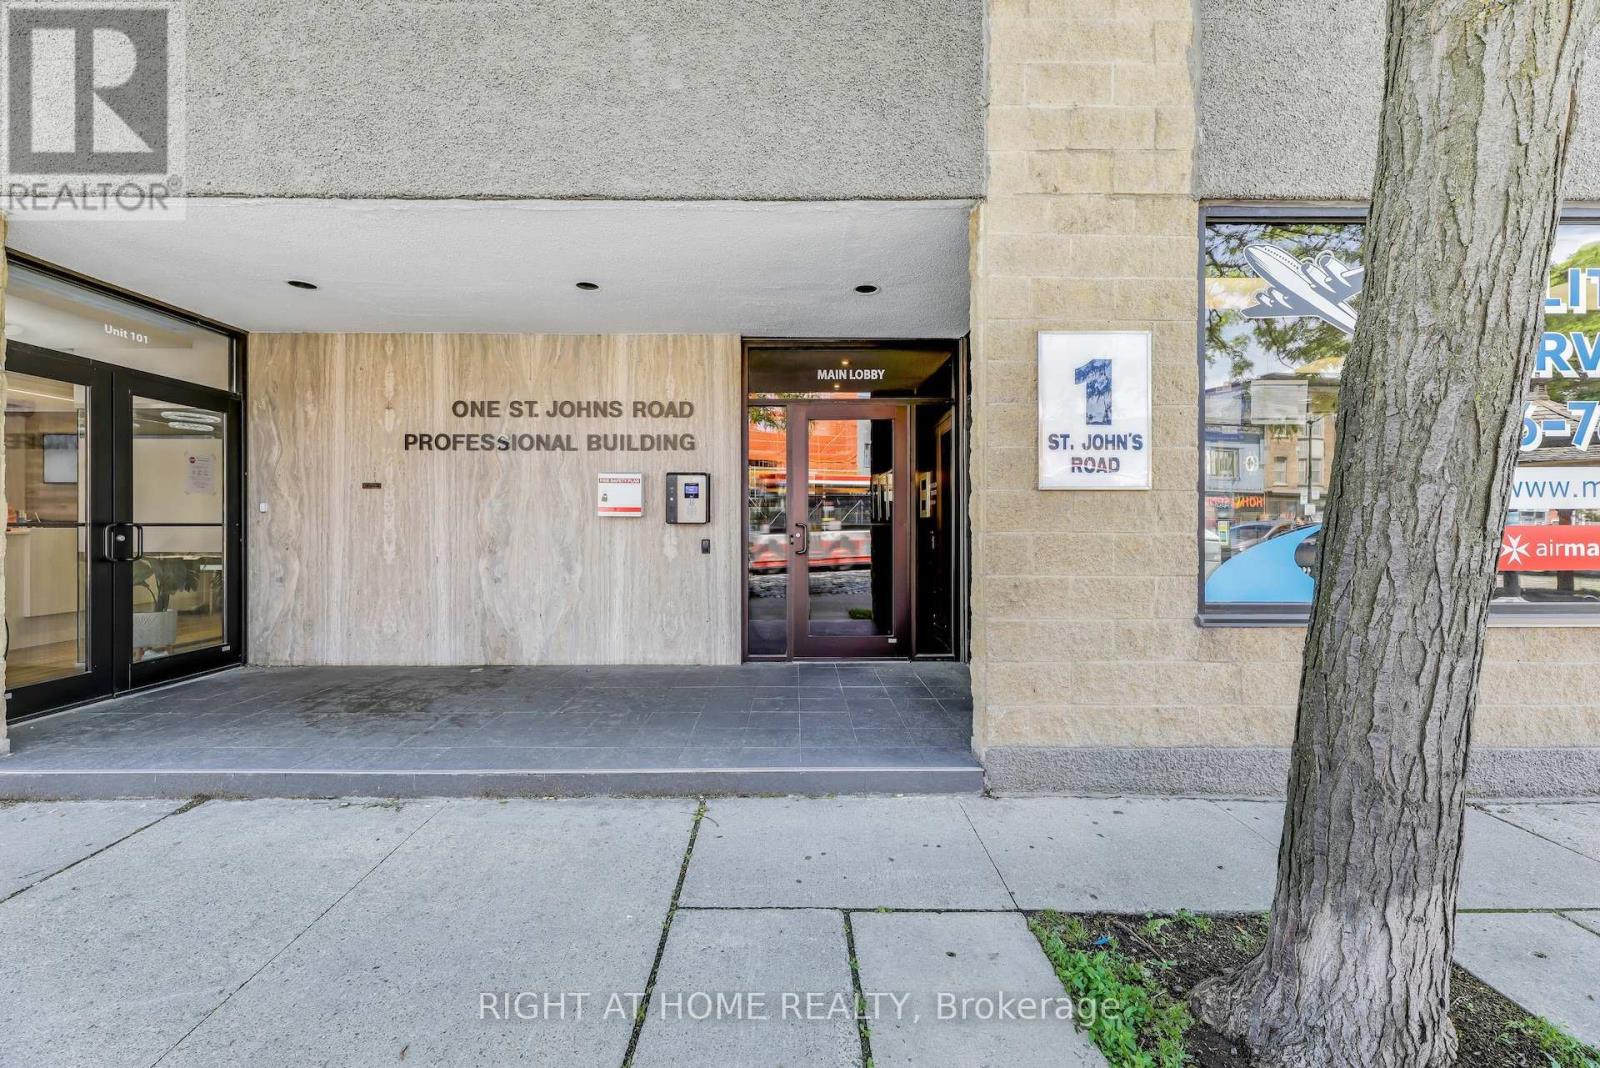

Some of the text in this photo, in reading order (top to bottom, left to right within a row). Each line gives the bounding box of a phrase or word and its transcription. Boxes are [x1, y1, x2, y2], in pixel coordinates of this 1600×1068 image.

[104, 323, 149, 344] Unit 101
[817, 369, 886, 380] MAIN LOBBY
[1074, 358, 1113, 426] 1
[452, 400, 695, 418] ONE ST. JOHNS ROAD
[404, 433, 697, 452] PROFESSIONAL BUILDING
[1048, 432, 1144, 451] ST. JOHN'S
[1071, 456, 1121, 474] ROAD
[1535, 539, 1600, 557] airma
